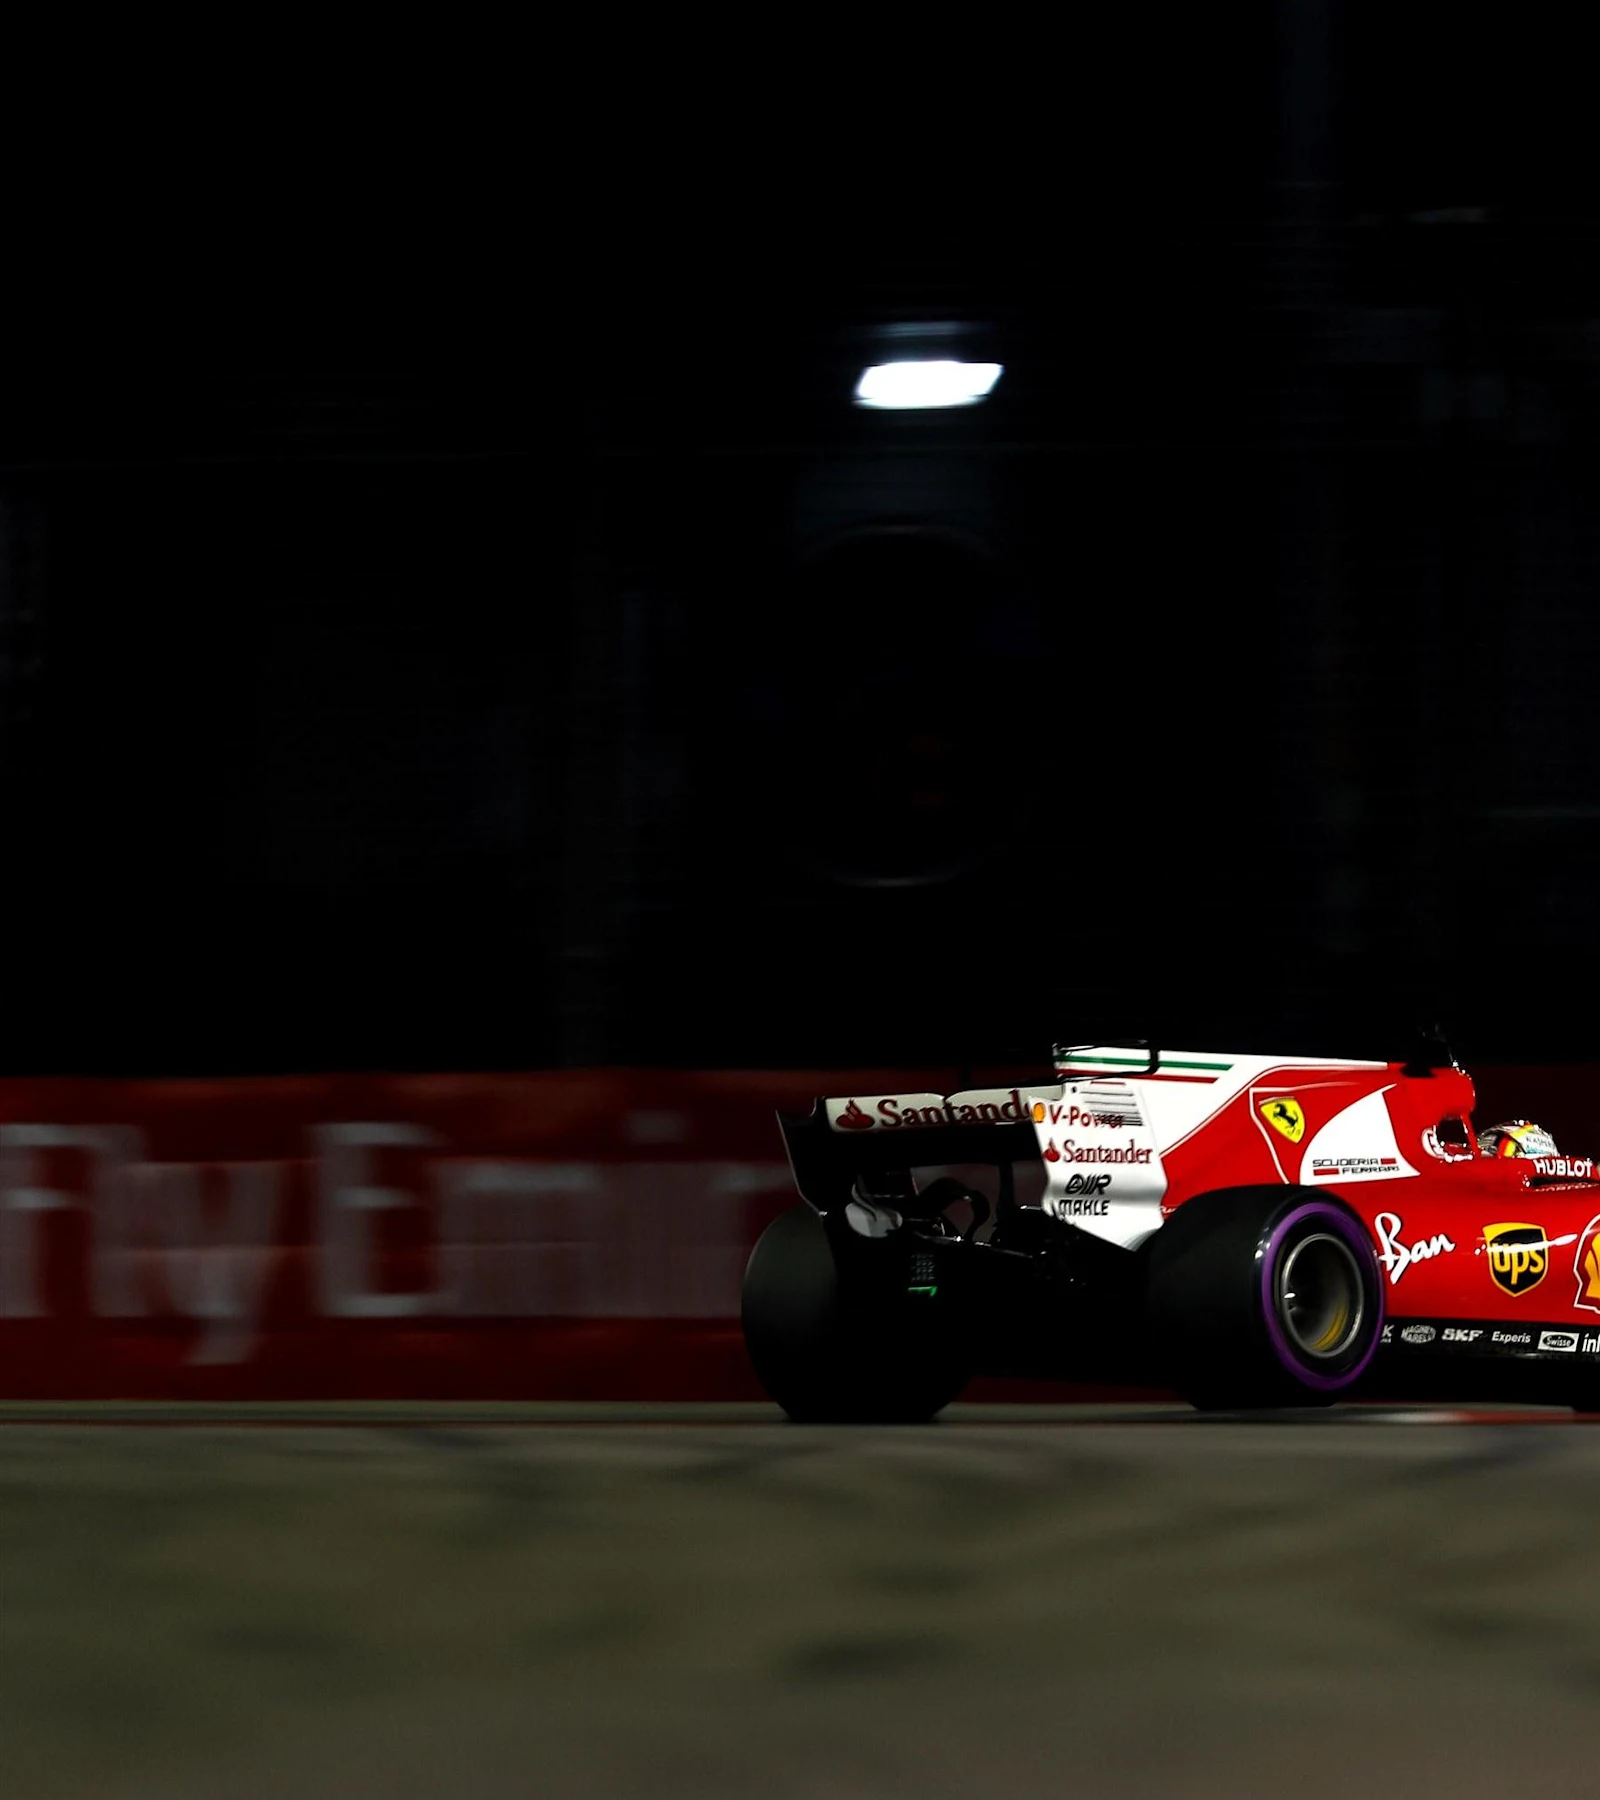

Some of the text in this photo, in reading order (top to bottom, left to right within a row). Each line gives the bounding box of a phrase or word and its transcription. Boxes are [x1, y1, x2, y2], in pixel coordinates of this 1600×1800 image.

[877, 1088, 1030, 1127] Santand
[1063, 1138, 1153, 1164] Santander
[1312, 1158, 1379, 1167] SCUDERIA
[1533, 1158, 1592, 1177] HUBLOT
[1059, 1200, 1110, 1217] MAHLE
[1492, 1243, 1545, 1285] ups
[1441, 1328, 1484, 1342] SKF
[1492, 1330, 1532, 1344] Experis
